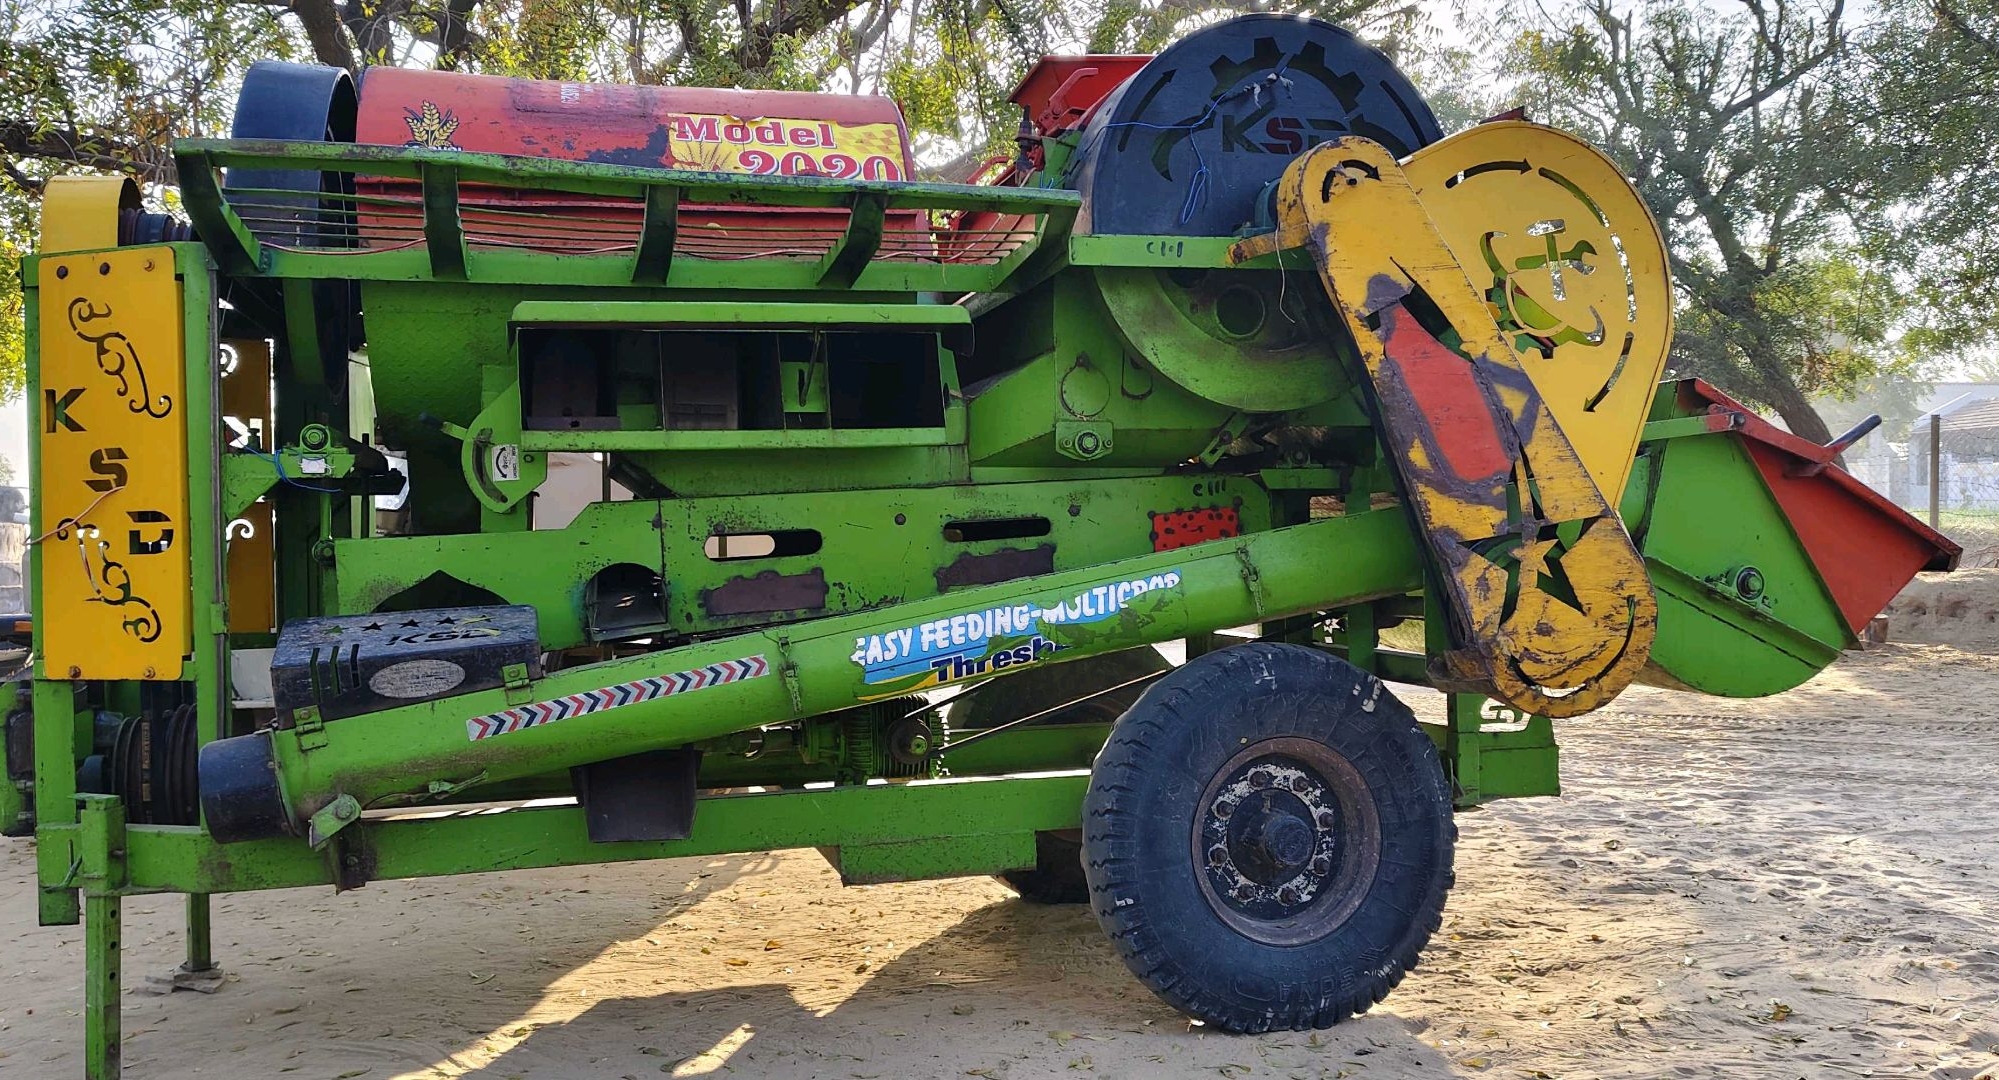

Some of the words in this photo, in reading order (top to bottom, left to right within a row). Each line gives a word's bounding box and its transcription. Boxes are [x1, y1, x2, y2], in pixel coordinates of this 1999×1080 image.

[674, 115, 837, 149] Model
[738, 150, 903, 182] 2020
[850, 627, 913, 666] EASY
[929, 635, 1072, 683] Thresh
